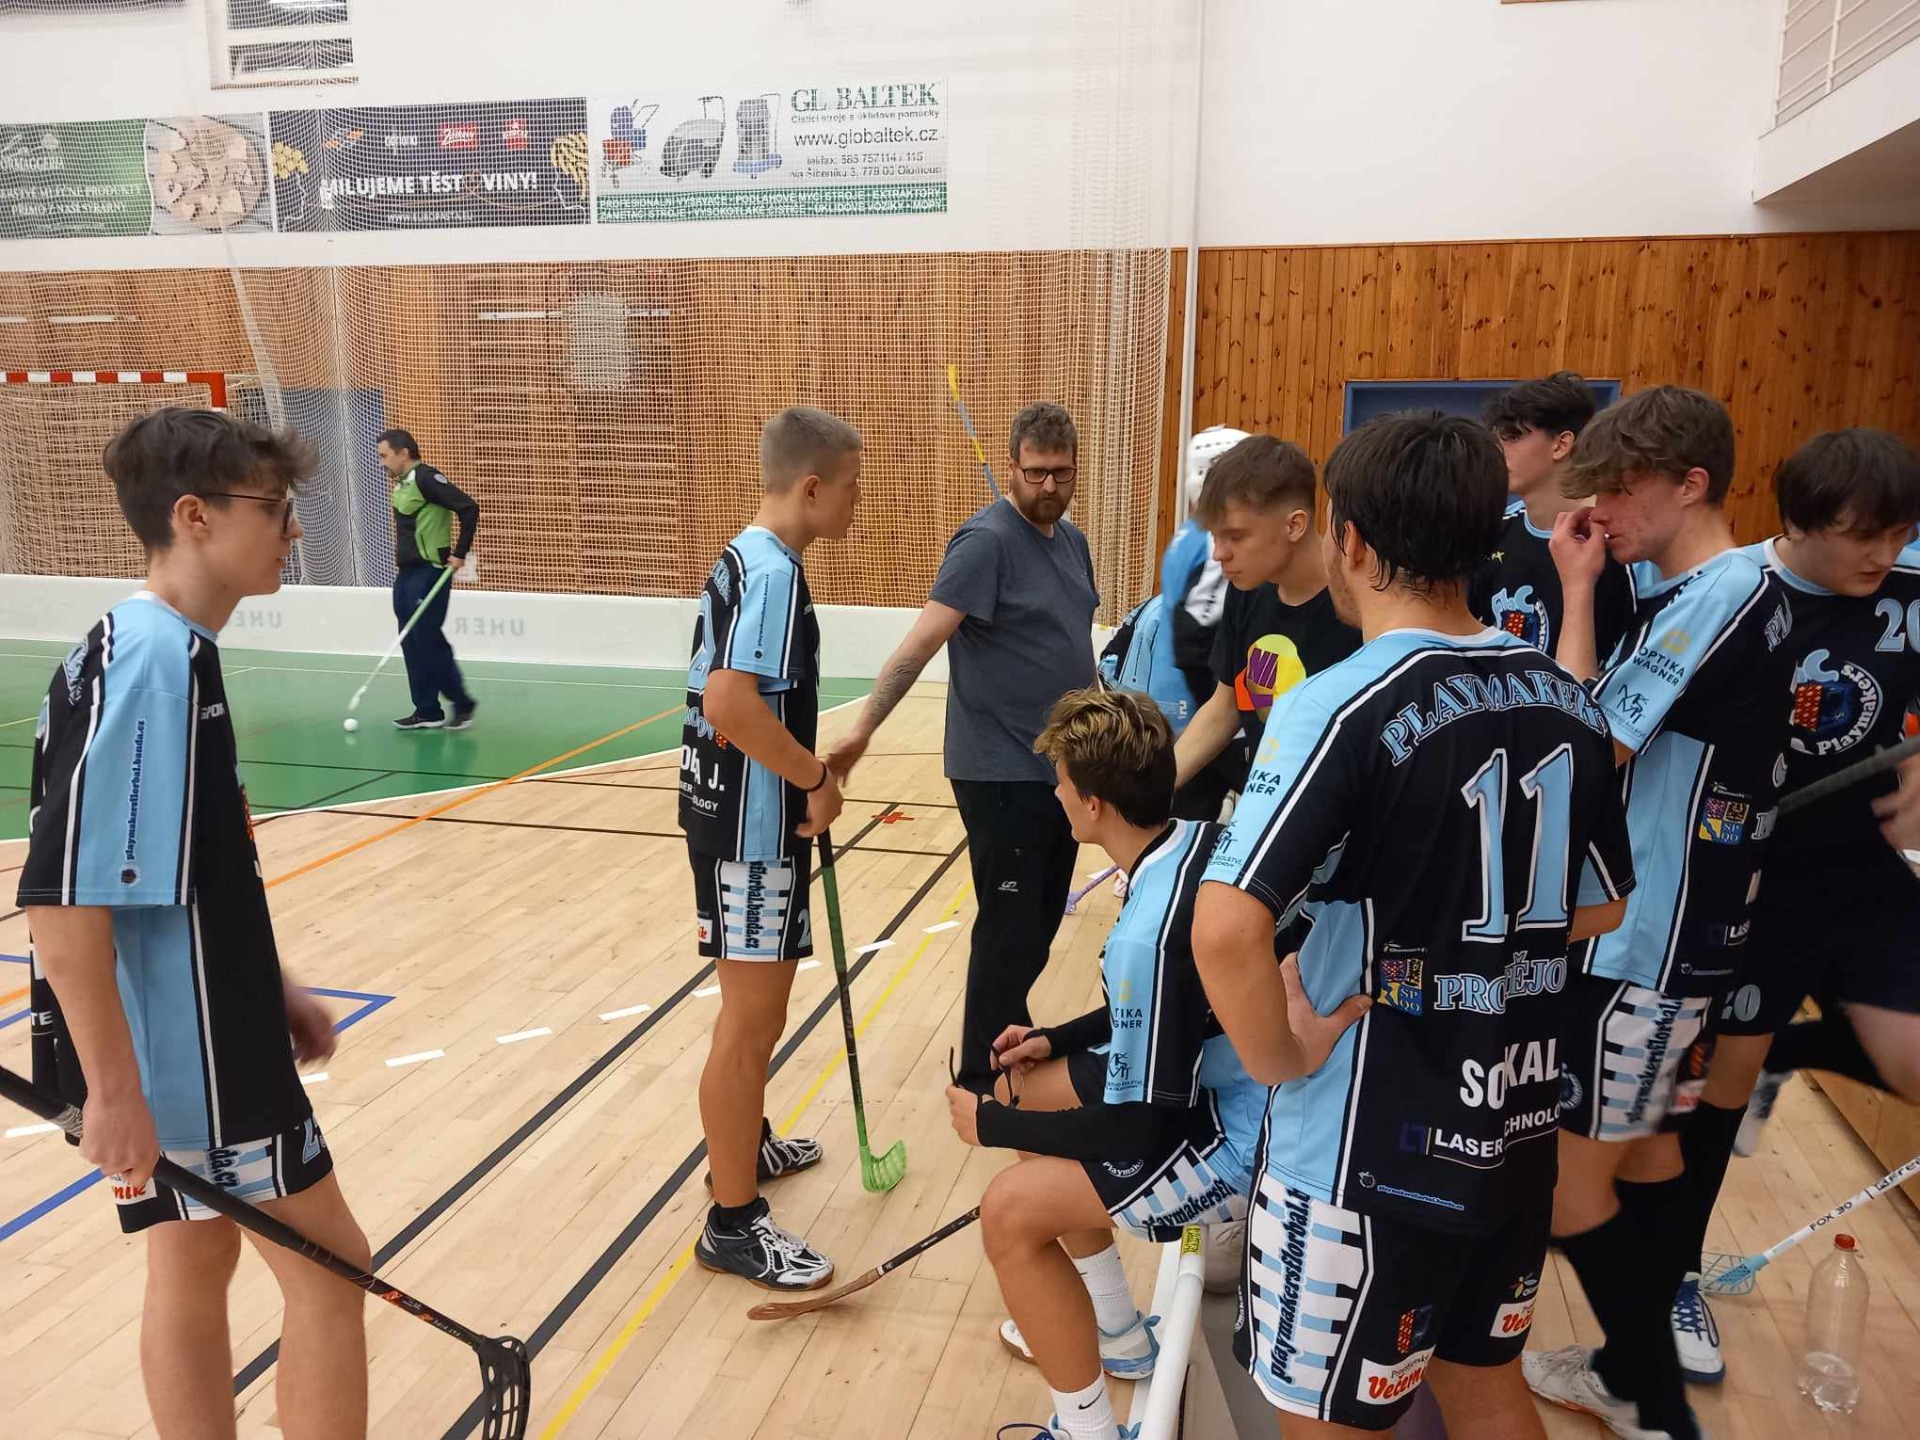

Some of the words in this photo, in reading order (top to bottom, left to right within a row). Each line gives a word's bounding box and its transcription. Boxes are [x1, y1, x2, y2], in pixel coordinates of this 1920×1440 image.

[793, 126, 939, 149] www.globaltek.cz
[320, 175, 414, 199] MILUJEME
[1632, 655, 1680, 687] WAGNER
[1638, 646, 1686, 678] OPTIKA
[1816, 663, 1878, 756] Playmakers
[1460, 742, 1575, 943] 11
[1434, 1127, 1503, 1158] LASER
[1809, 1212, 1835, 1231] FOX
